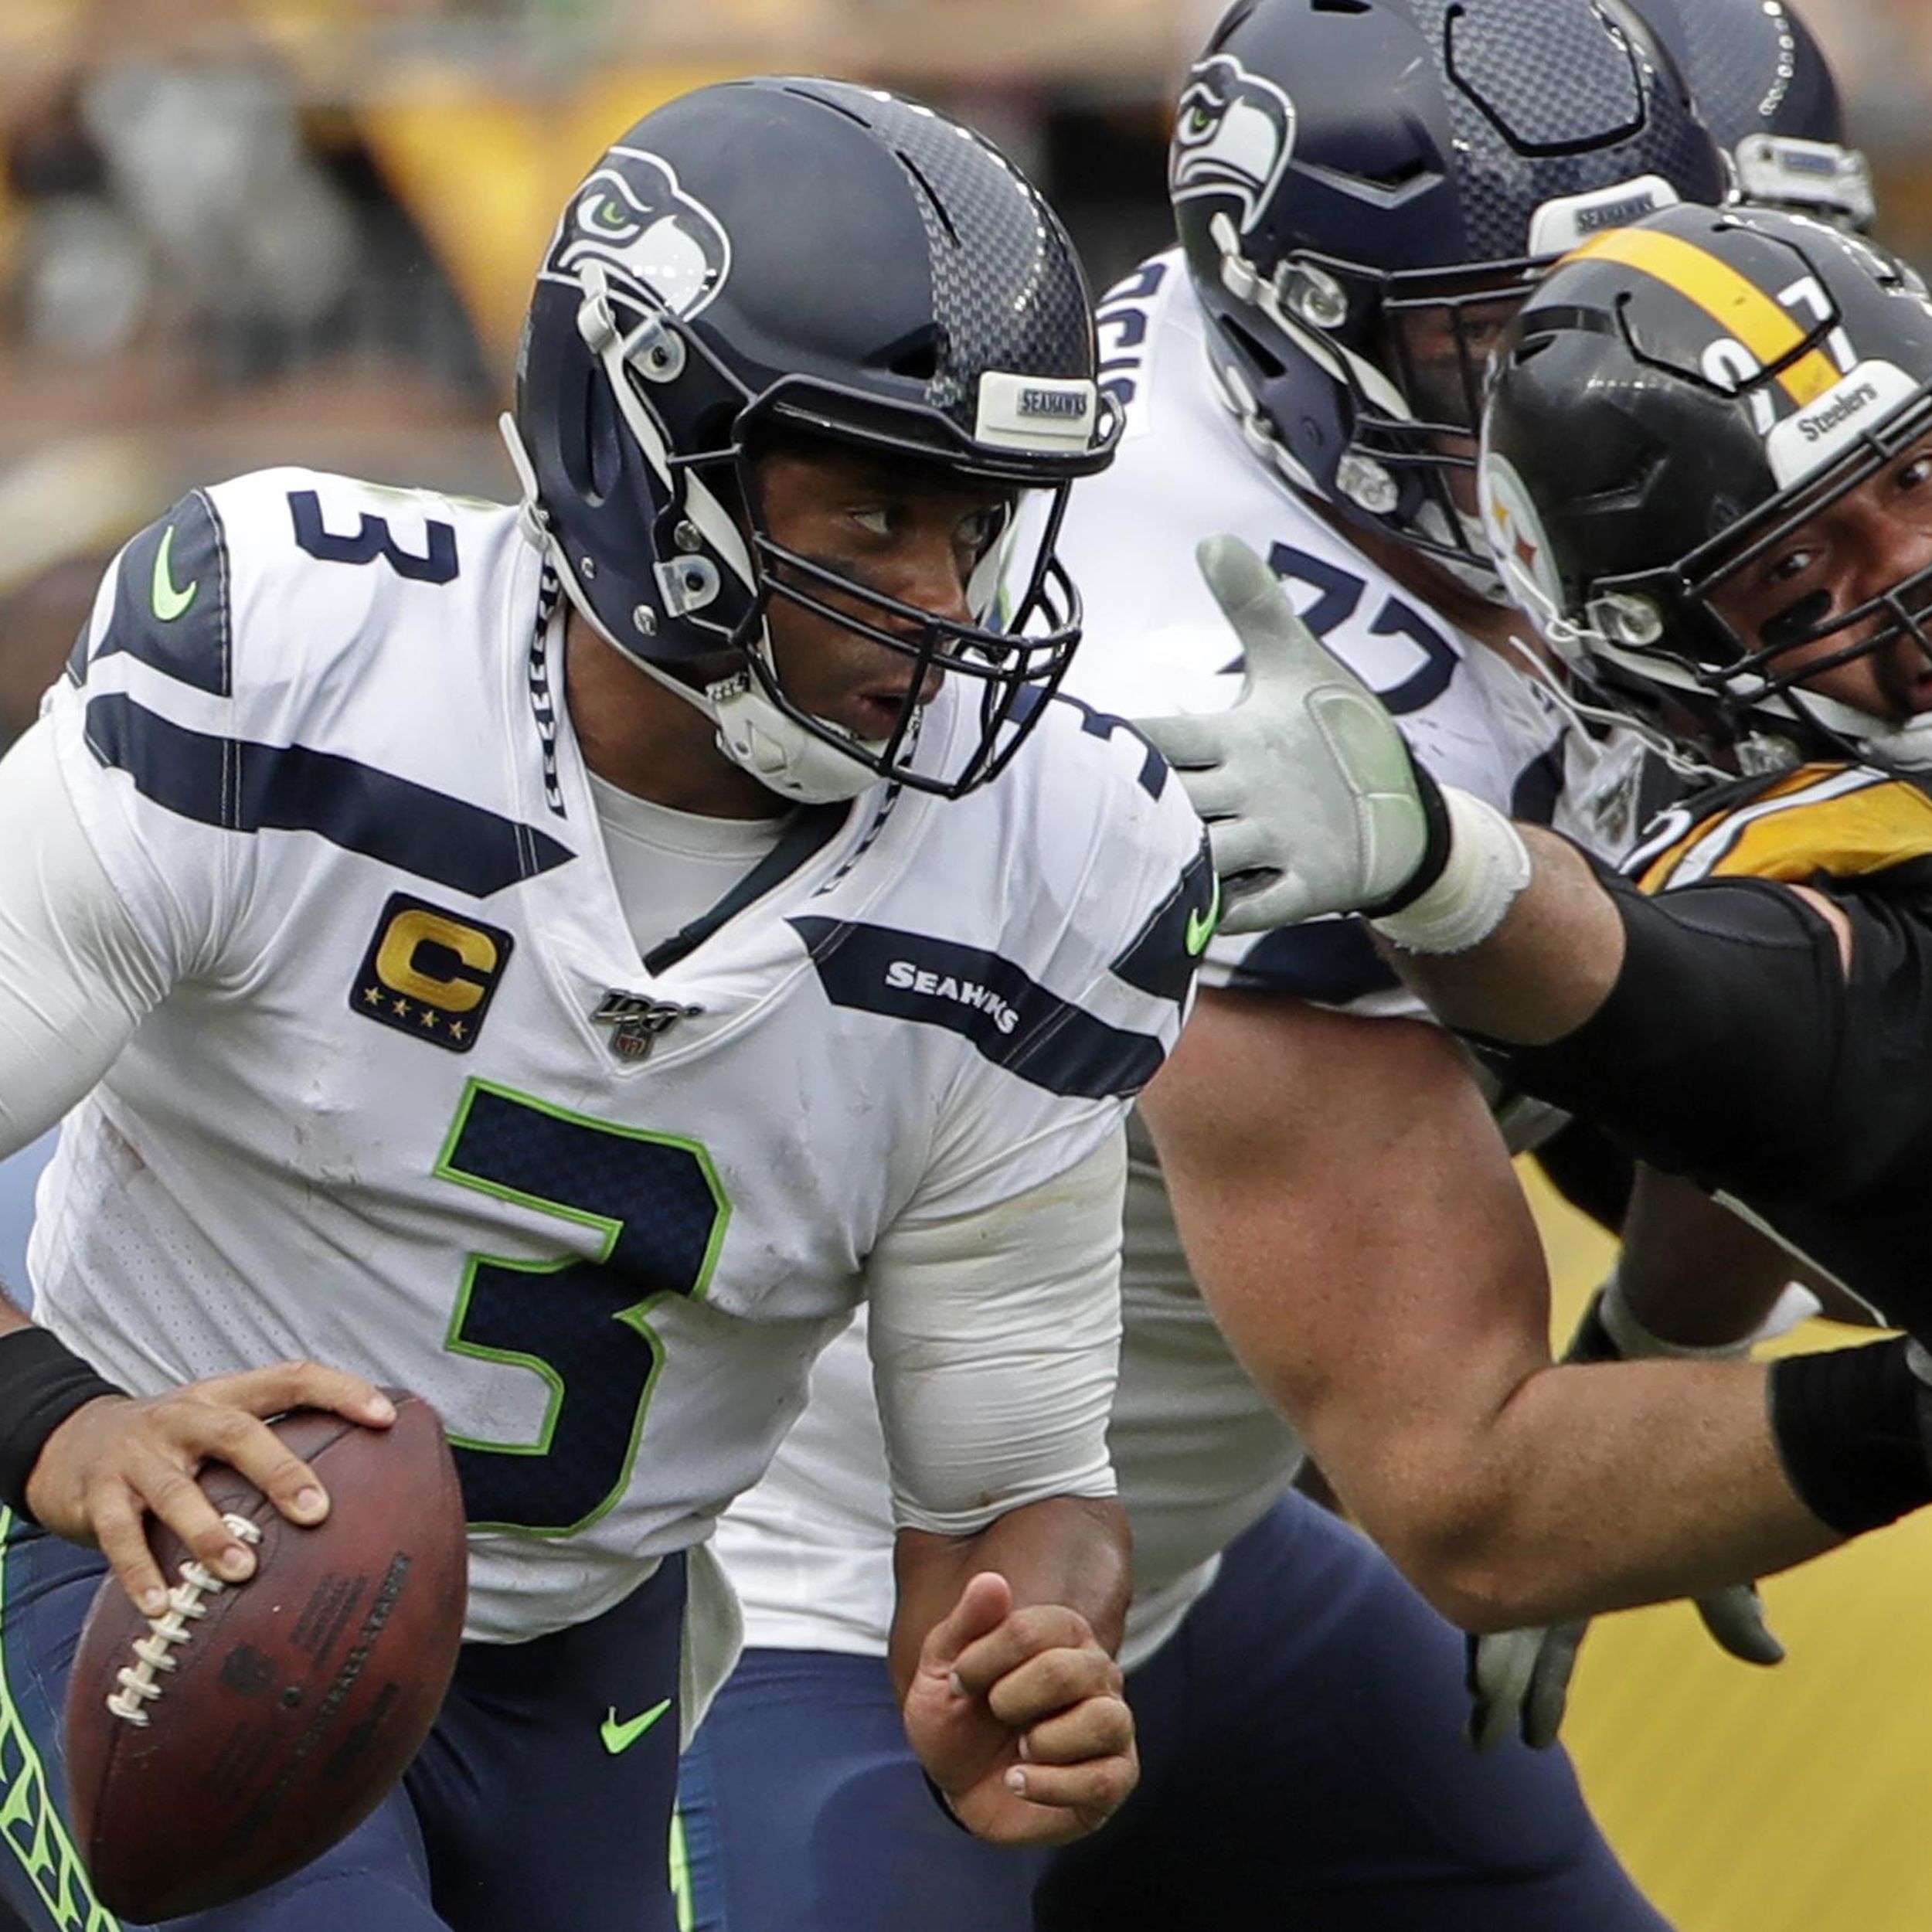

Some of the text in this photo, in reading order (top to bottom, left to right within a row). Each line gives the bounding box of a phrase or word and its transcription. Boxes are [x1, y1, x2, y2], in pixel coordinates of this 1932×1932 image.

[1798, 381, 1879, 443] Steelers
[287, 488, 460, 586] 3
[376, 909, 498, 1013] C
[433, 1075, 733, 1539] 3
